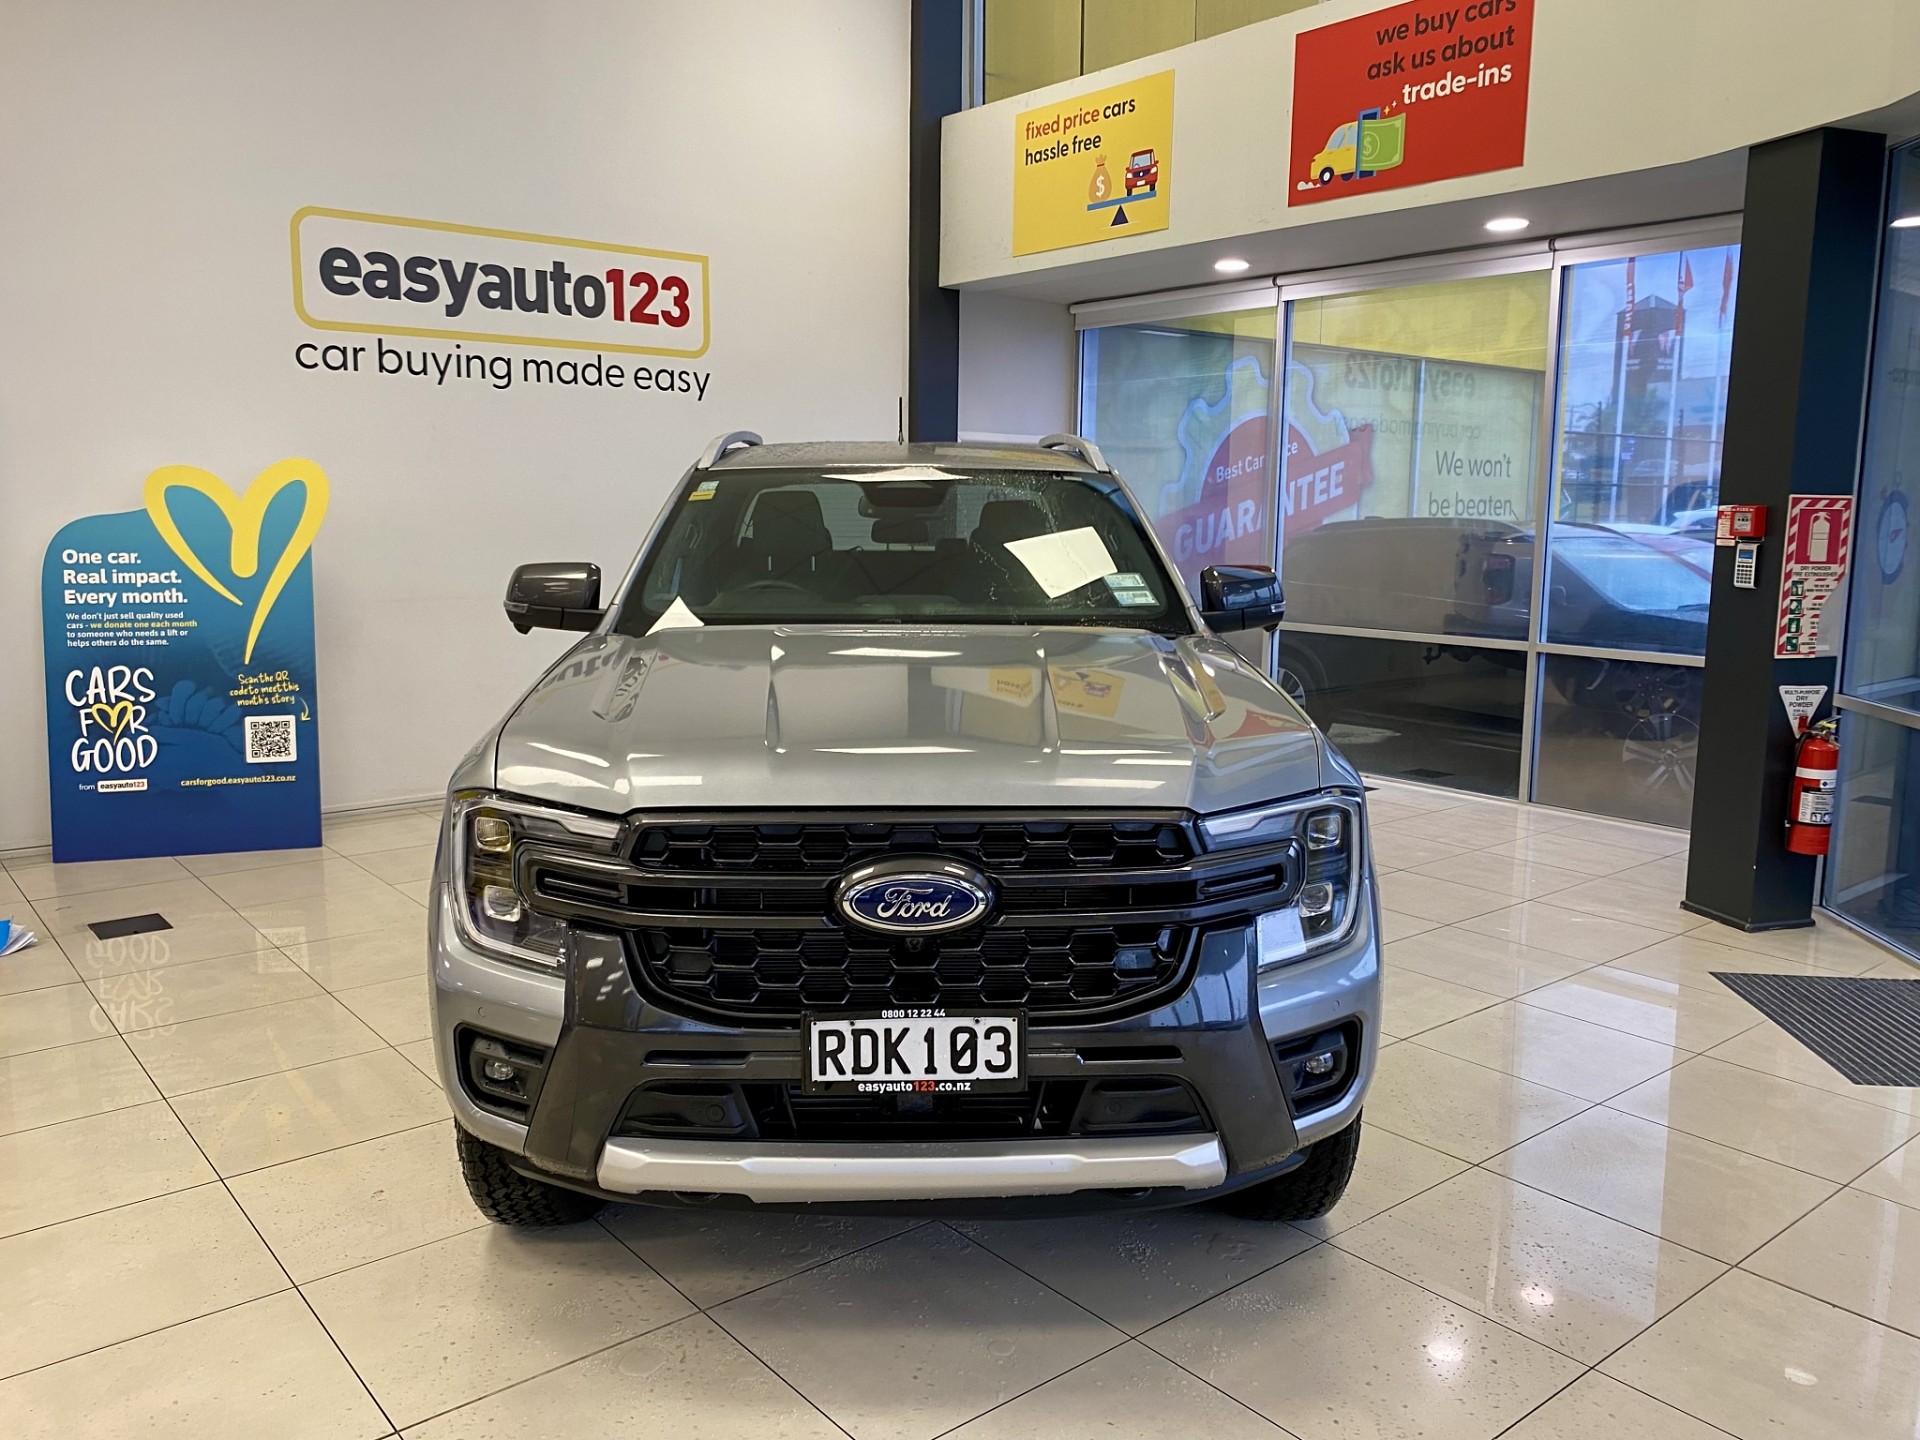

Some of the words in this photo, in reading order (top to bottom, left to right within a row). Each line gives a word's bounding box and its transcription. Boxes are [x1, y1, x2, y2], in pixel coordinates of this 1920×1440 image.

[1376, 23, 1409, 46] we
[1414, 9, 1460, 37] buy
[1464, 0, 1516, 23] cars
[1367, 51, 1405, 80] ask
[1411, 49, 1435, 70] us
[1441, 25, 1515, 62] about
[1402, 62, 1512, 105] trade-ins
[1025, 114, 1060, 141] fixed
[1063, 107, 1100, 135] price
[1103, 98, 1136, 119] cars
[1025, 140, 1069, 166] hassle
[1072, 134, 1102, 154] free
[318, 246, 691, 328] easyauto123
[295, 341, 366, 372] car
[378, 338, 511, 389] buying
[523, 353, 625, 388] made
[633, 366, 711, 402] easy
[1216, 461, 1243, 483] Best
[1245, 454, 1265, 473] Car
[1436, 450, 1463, 477] We
[1468, 453, 1512, 478] won't
[1428, 491, 1450, 517] be
[1455, 491, 1512, 517] beaten
[62, 549, 102, 564] One
[107, 551, 142, 565] car.
[63, 568, 108, 584] Real
[112, 569, 182, 588] impact.
[64, 589, 117, 608] Every
[122, 588, 188, 604] month.
[81, 612, 102, 620] don't
[103, 612, 119, 622] just
[120, 612, 134, 620] sell
[136, 612, 163, 622] quality
[165, 611, 184, 619] used
[104, 620, 132, 629] donate
[151, 620, 170, 628] each
[172, 620, 197, 628] month
[67, 639, 90, 649] helps
[91, 639, 117, 647] others
[131, 638, 144, 646] the
[145, 638, 169, 646] same.
[116, 629, 134, 637] who
[135, 629, 159, 637] needs
[167, 629, 178, 637] lift
[65, 665, 156, 707] CARS
[230, 687, 247, 696] code
[248, 686, 259, 695] to
[261, 683, 281, 693] meet
[281, 681, 300, 692] this
[238, 673, 259, 684] Scan
[259, 672, 274, 683] the
[275, 670, 290, 682] QR
[237, 695, 270, 706] month's
[271, 693, 295, 705] story
[71, 734, 158, 773] GOOD
[100, 781, 145, 791] easyauto123
[180, 774, 297, 787] carsforgood.easyauto123.co.nz
[876, 886, 953, 918] Ford
[881, 1009, 906, 1019] 0800
[907, 1009, 919, 1018] 12
[920, 1009, 932, 1018] 22
[933, 1008, 946, 1018] 44
[818, 1025, 1012, 1076] RDK103
[857, 1080, 972, 1094] easyauto123.co.nz
